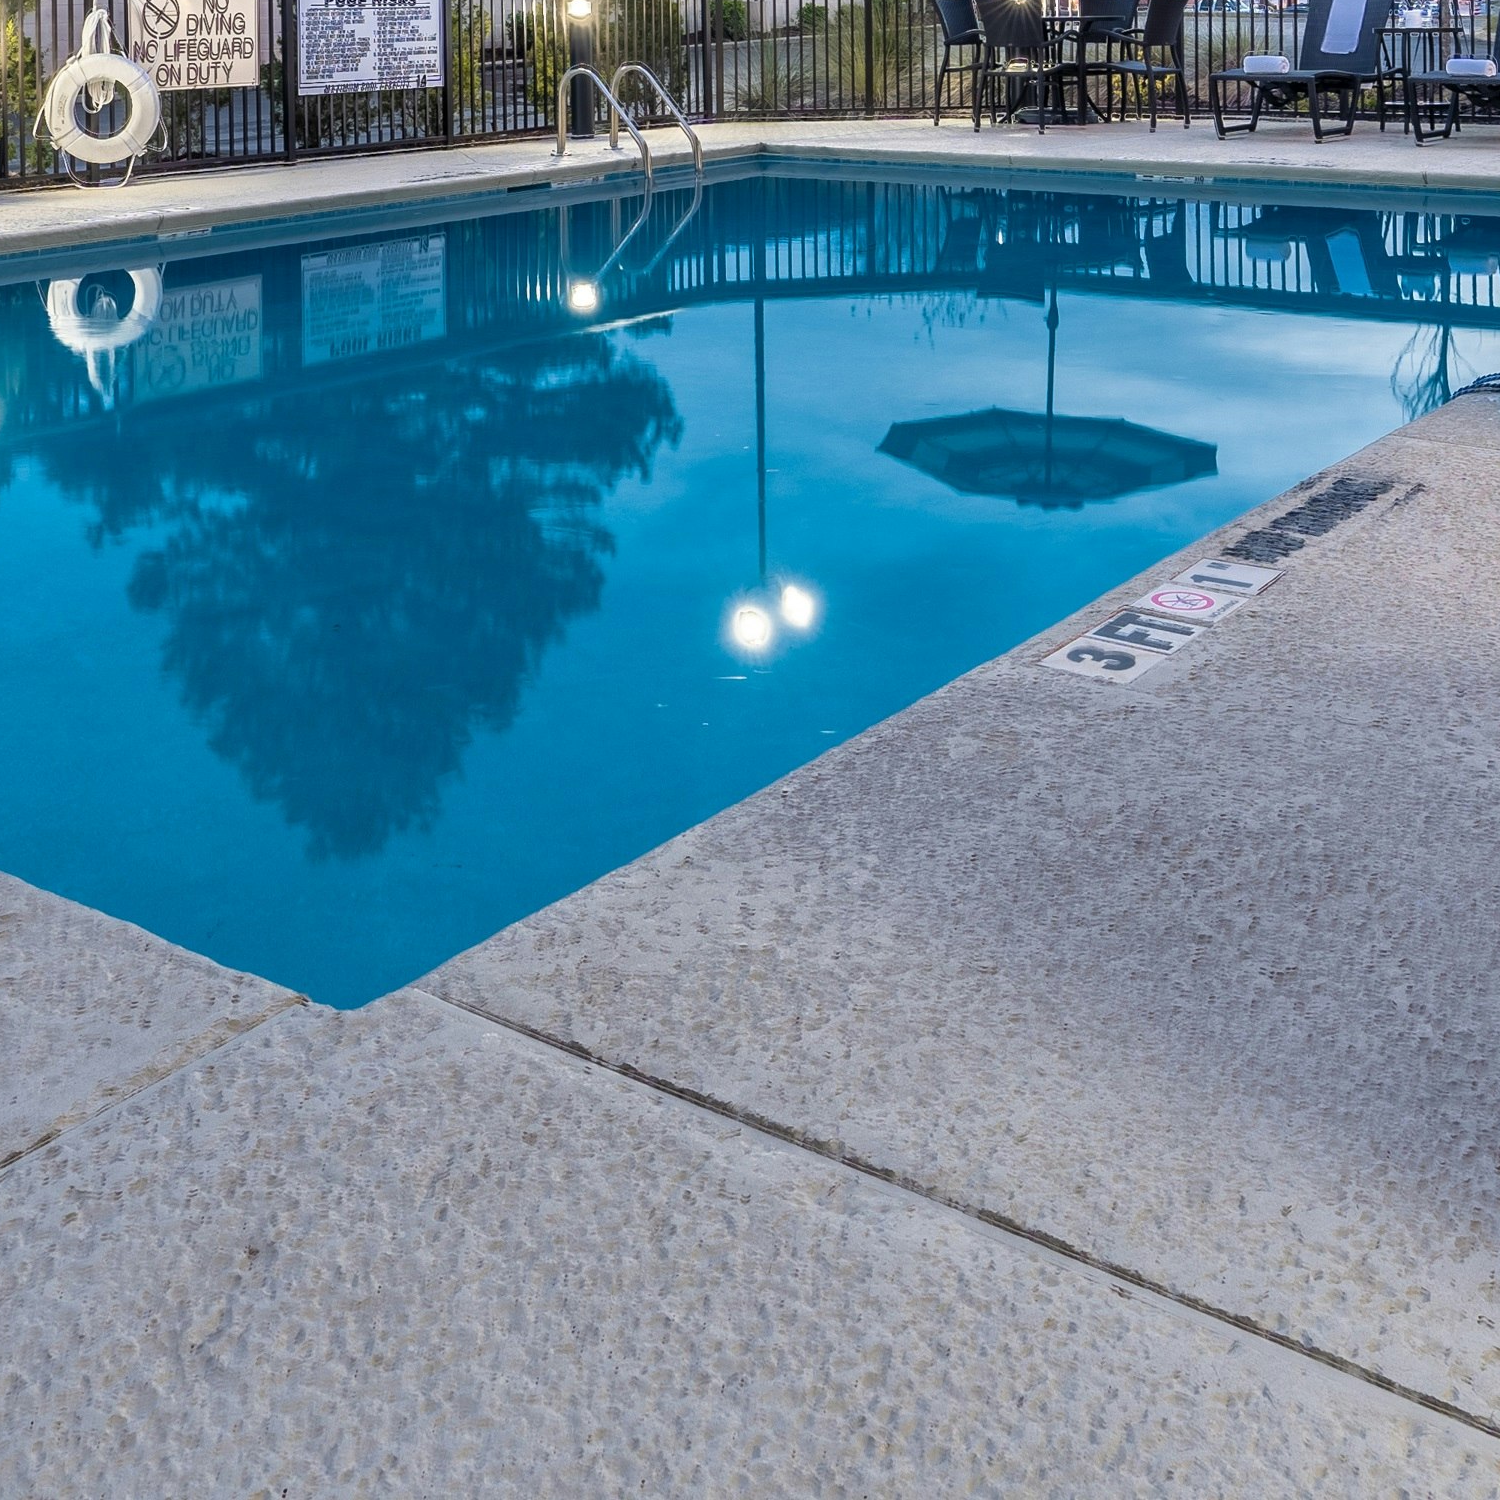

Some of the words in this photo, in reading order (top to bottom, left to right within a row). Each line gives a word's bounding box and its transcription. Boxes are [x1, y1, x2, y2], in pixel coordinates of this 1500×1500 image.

[186, 12, 246, 36] DIVING
[133, 40, 159, 64] NO
[164, 37, 255, 62] LIFEGUARD
[156, 63, 181, 86] ON
[186, 61, 234, 85] DUTY
[1190, 573, 1254, 588] 1
[1092, 611, 1199, 651] FT
[1066, 645, 1137, 672] 3
